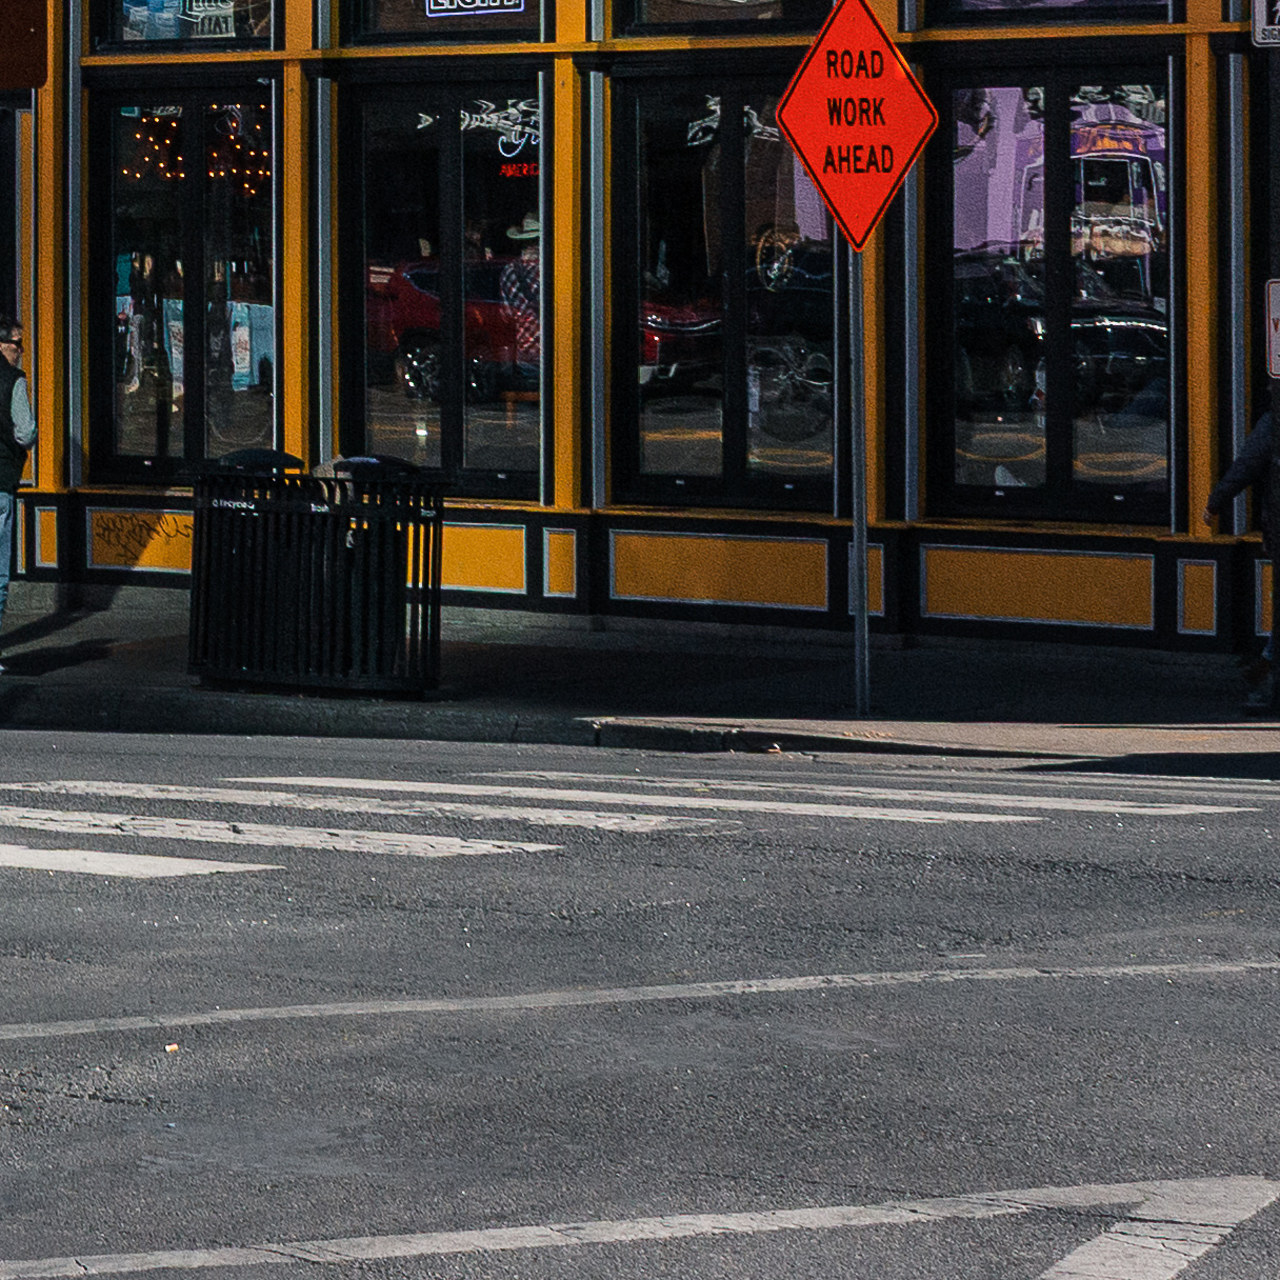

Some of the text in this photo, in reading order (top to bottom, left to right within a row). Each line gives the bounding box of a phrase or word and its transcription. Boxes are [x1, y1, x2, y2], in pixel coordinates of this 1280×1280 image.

[825, 50, 885, 79] ROAD
[826, 97, 887, 127] WORK
[822, 145, 895, 175] AHEAD
